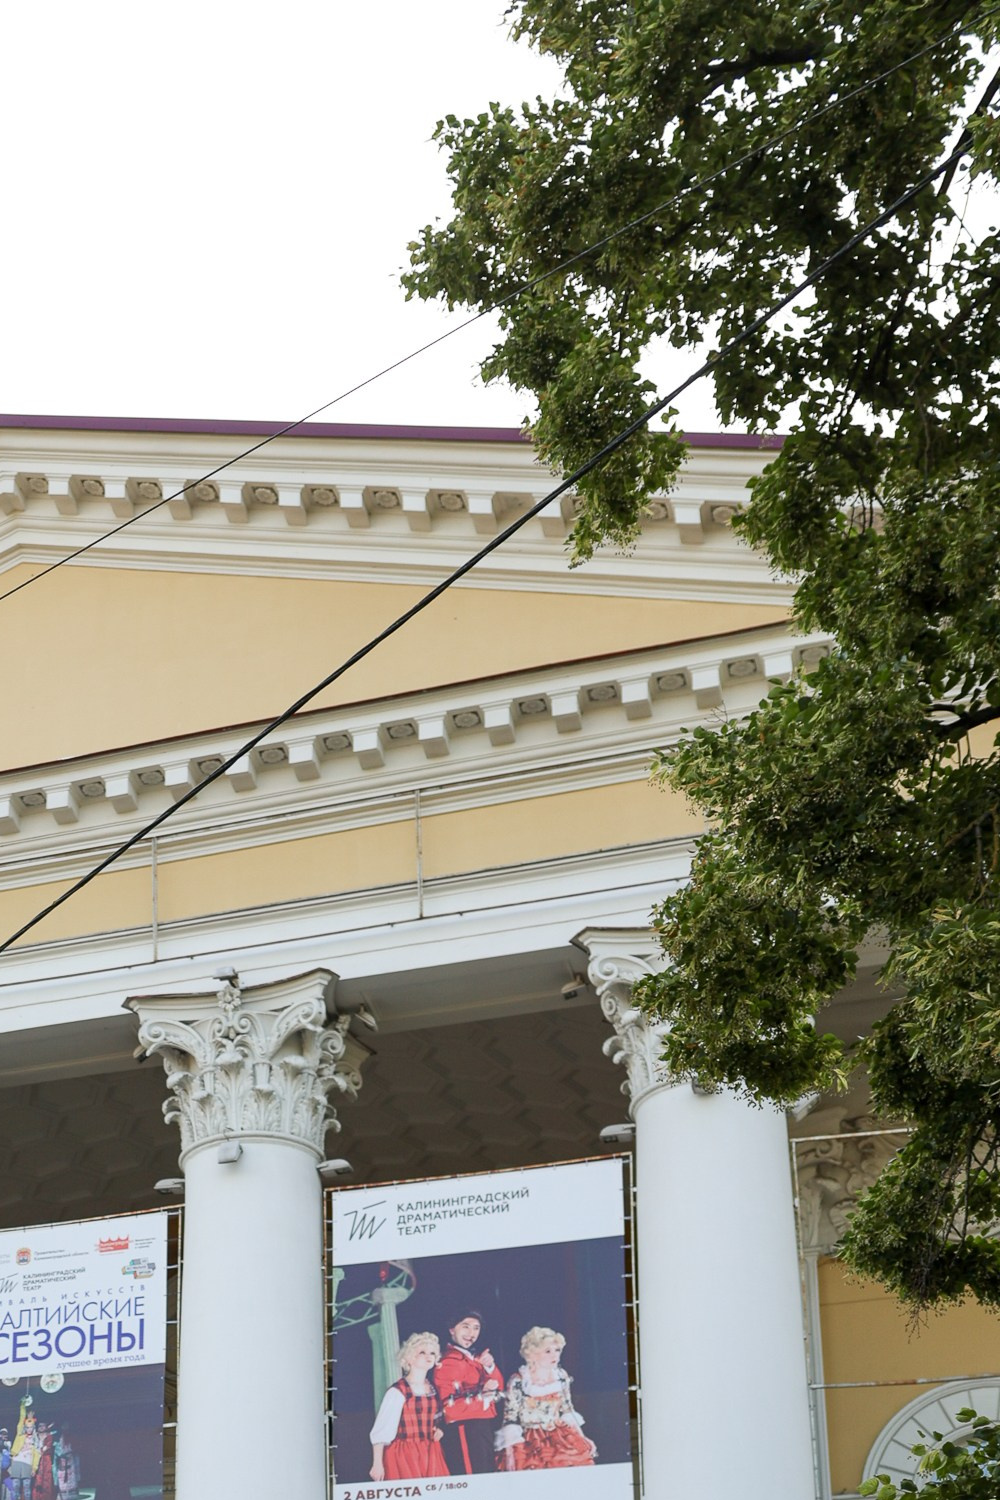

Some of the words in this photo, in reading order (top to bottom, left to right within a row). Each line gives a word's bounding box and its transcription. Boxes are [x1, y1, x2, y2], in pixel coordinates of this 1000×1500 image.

[397, 1188, 530, 1212] КАЛИНИНГРАДСКИЙ
[397, 1202, 510, 1226] ДРАМАТИЧЕСКИЙ
[397, 1224, 436, 1236] ТЕАТР
[23, 1267, 86, 1280] КАЛИНИНГРАДСКИЙ
[23, 1274, 77, 1286] ДРАМАТИЧЕСКИЙ
[61, 1284, 145, 1299] ИСКУССТВ
[56, 1359, 91, 1369] лучшее
[94, 1357, 123, 1367] время
[125, 1354, 145, 1362] года
[355, 1486, 421, 1500] АВГУСТА
